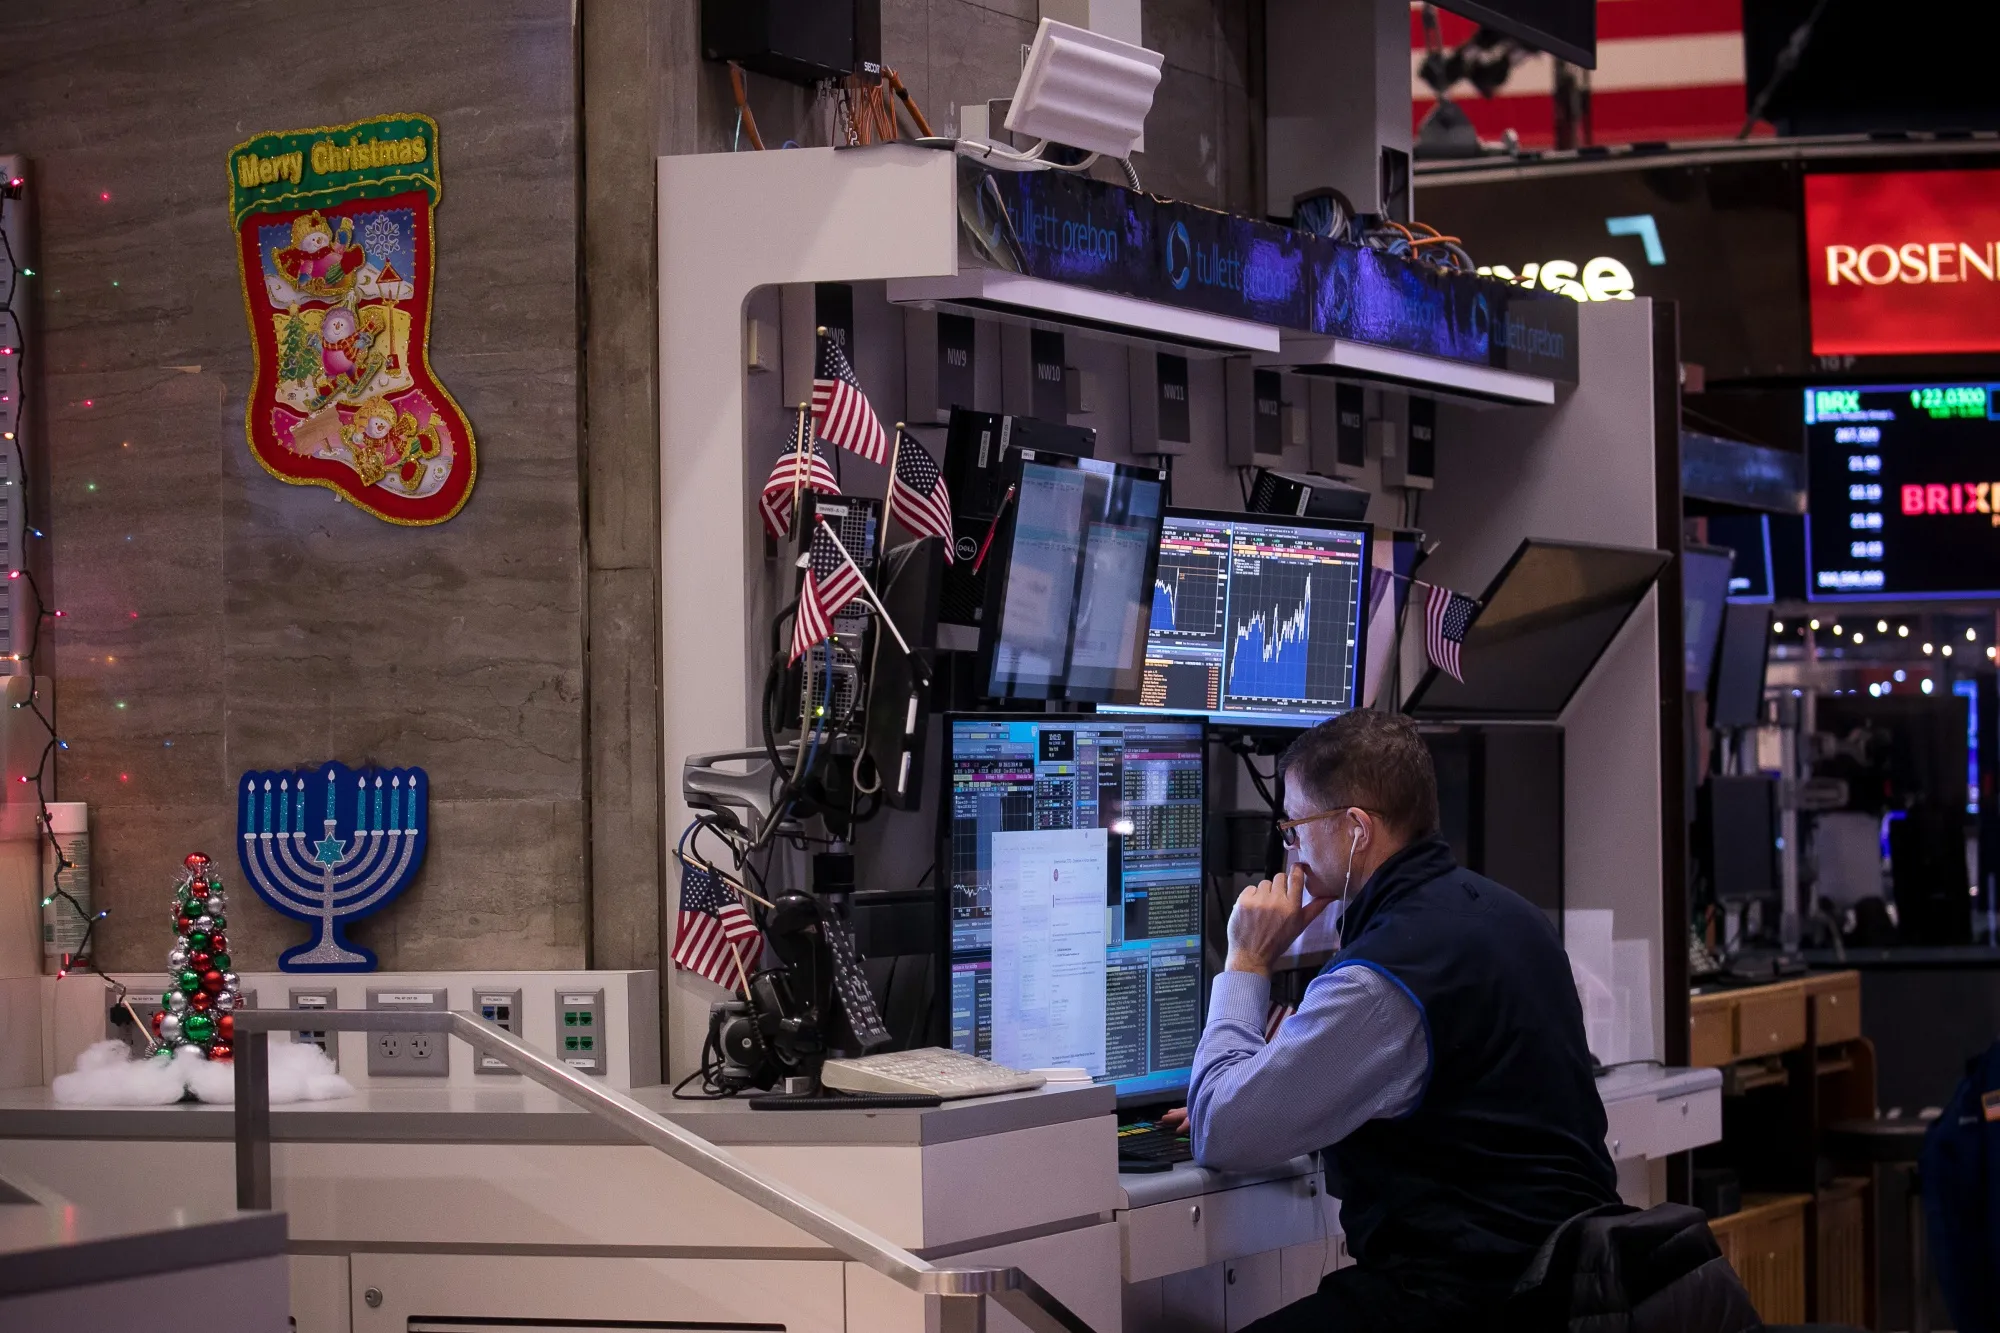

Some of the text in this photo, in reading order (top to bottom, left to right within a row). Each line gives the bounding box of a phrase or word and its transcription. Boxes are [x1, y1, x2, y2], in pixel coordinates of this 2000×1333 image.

[238, 135, 427, 188] Merry Christmas
[1007, 196, 1118, 263] tullett prebon
[1196, 241, 1241, 292] tullett
[947, 347, 967, 367] NW9
[1038, 363, 1061, 382] NW10
[1163, 384, 1184, 401] NW11
